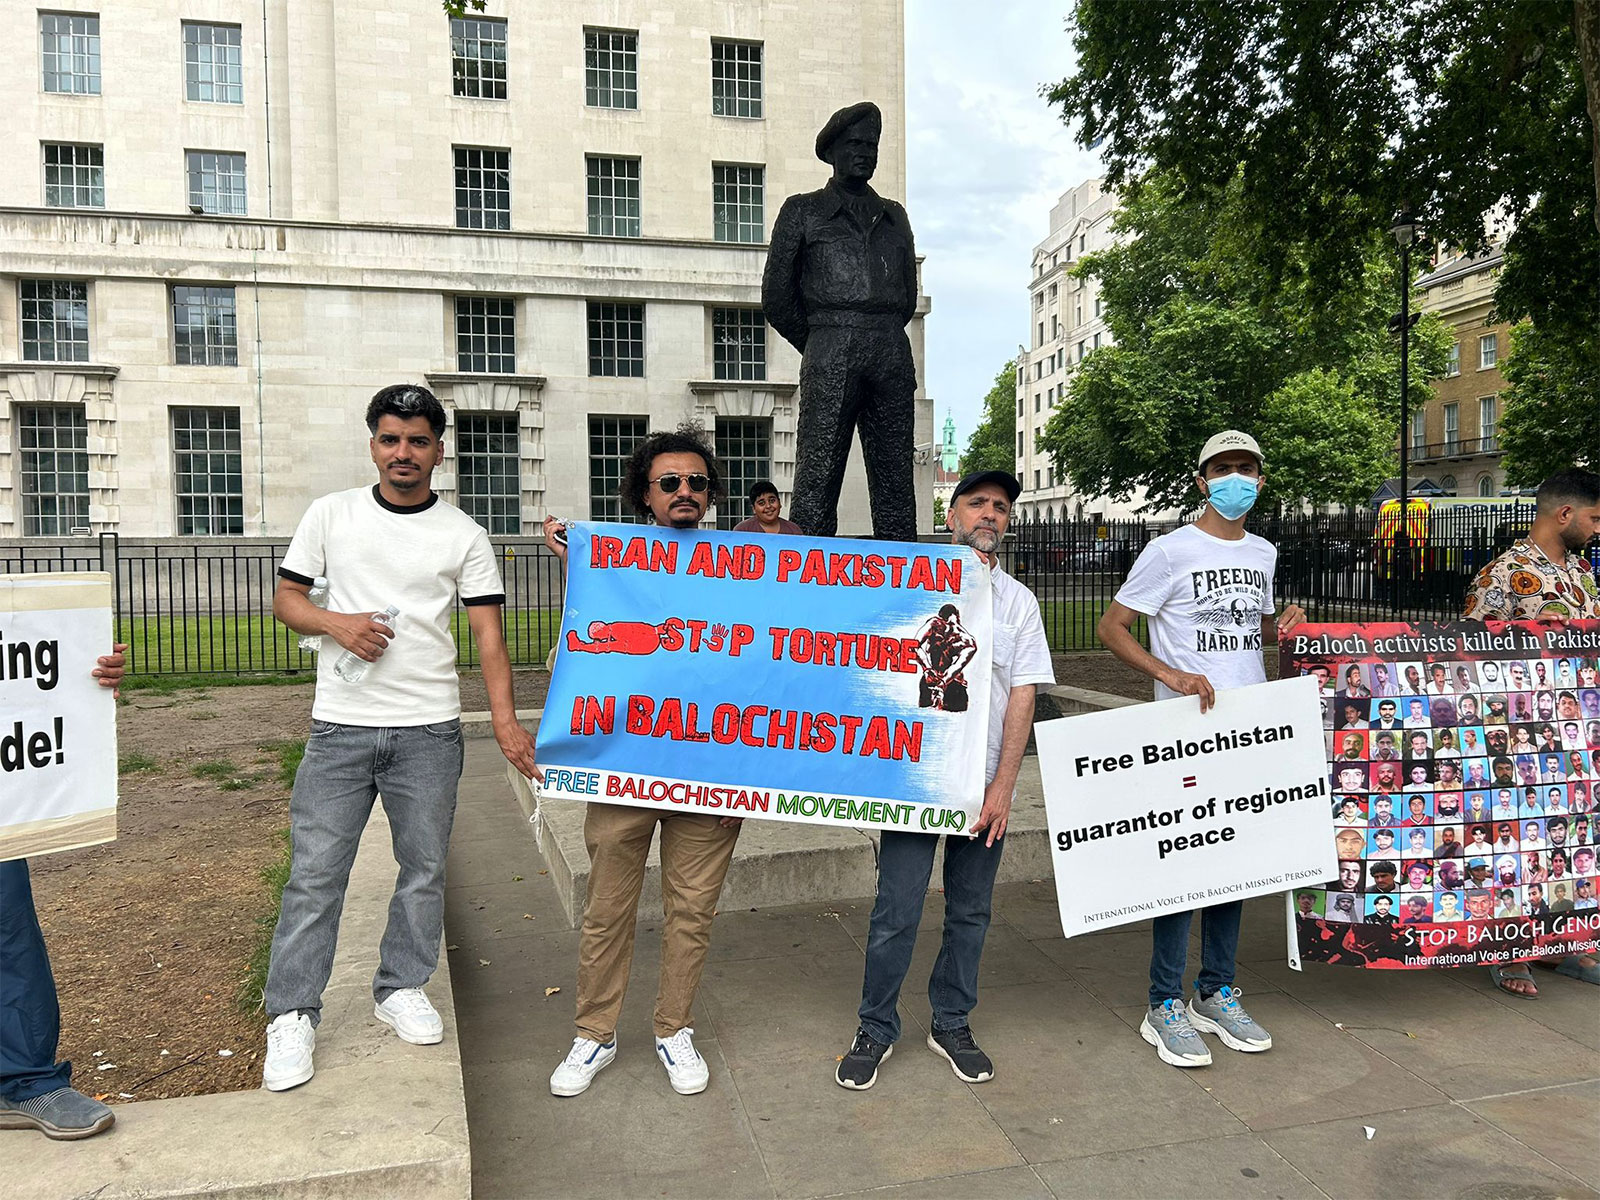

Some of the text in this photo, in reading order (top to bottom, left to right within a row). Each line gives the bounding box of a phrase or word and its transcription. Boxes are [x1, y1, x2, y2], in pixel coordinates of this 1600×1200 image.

[591, 534, 962, 595] IRAN AND PAKISTAN
[1215, 589, 1223, 597] TO
[769, 628, 919, 674] TORTURE
[1196, 629, 1238, 652] HARD
[1293, 634, 1368, 655] Baloch
[1374, 635, 1456, 654] activists
[1461, 630, 1516, 651] killed
[1521, 632, 1541, 650] in
[0, 716, 64, 772] de!
[571, 695, 923, 762] IN BALOCHISTAN
[1075, 724, 1294, 777] Free Balochistan
[544, 768, 966, 832] FREE BALOCHISTAN MOVEMENT (UK)
[1057, 777, 1326, 851] guarantor of regional
[1158, 826, 1235, 858] peace
[1405, 951, 1476, 966] International
[1479, 949, 1509, 961] Voice
